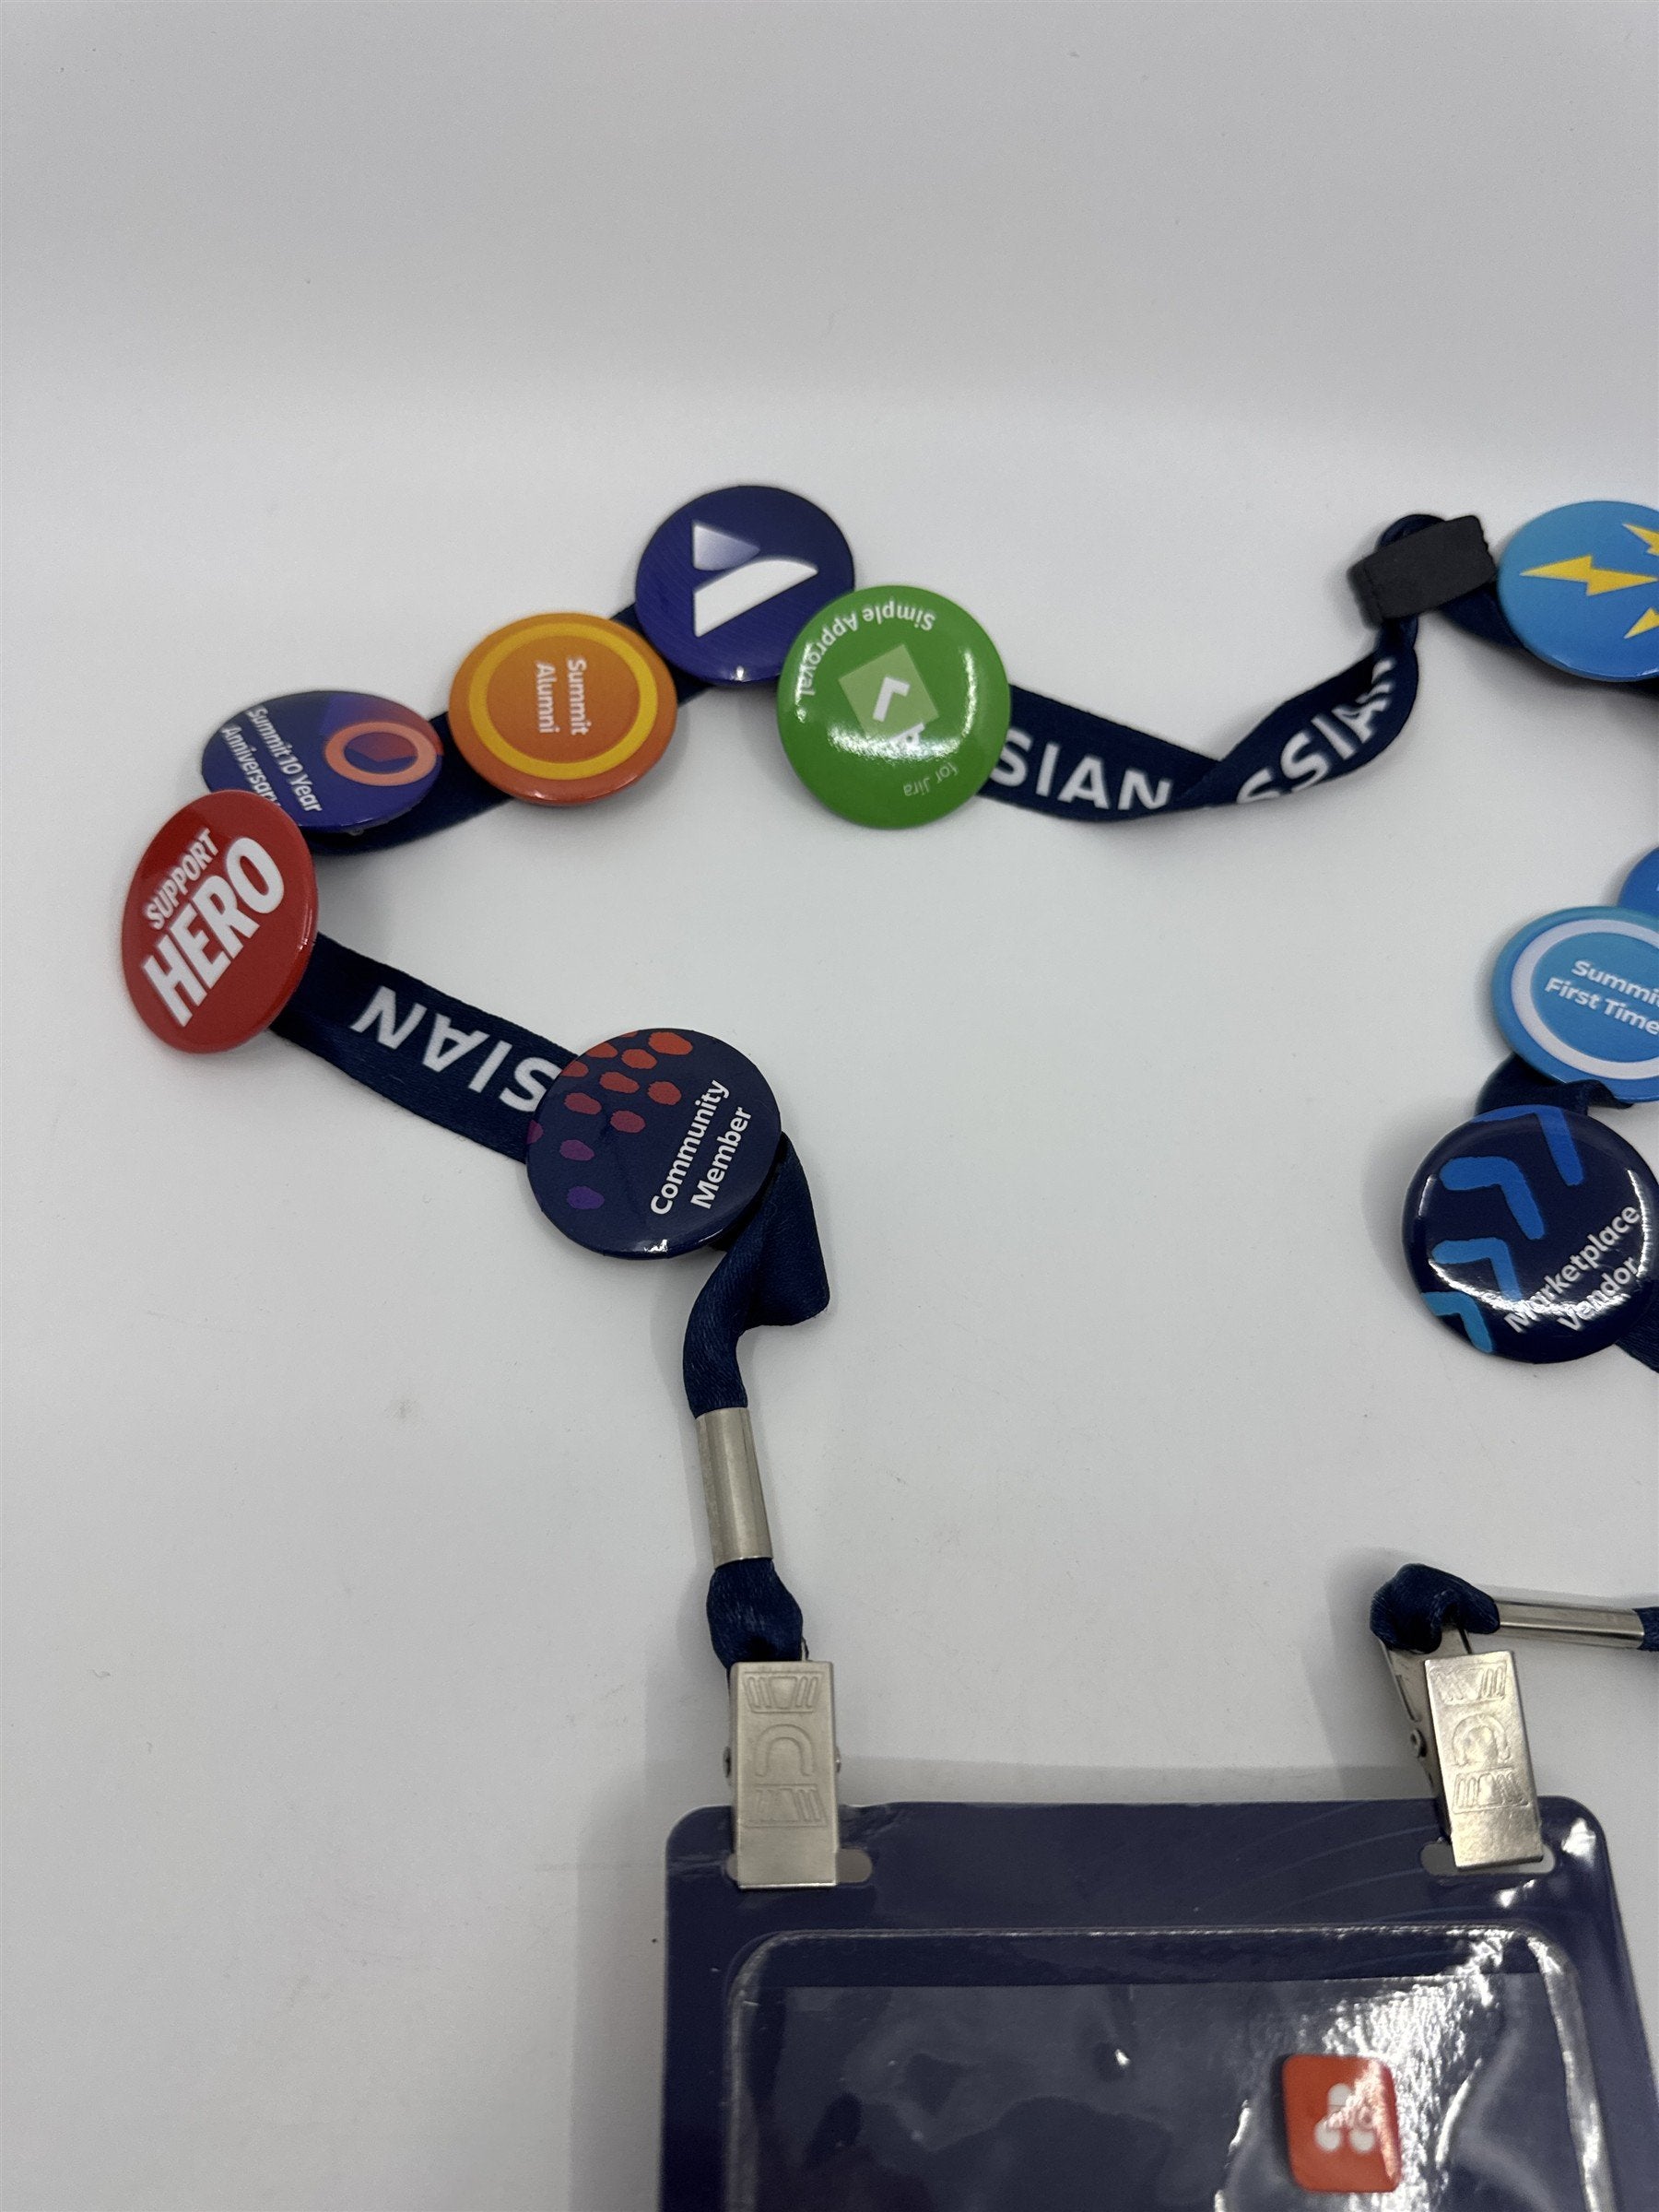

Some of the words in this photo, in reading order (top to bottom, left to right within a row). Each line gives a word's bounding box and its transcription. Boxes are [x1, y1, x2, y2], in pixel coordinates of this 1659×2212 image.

[863, 598, 936, 631] Simple
[798, 613, 858, 696] Approval
[247, 705, 292, 760] Summit
[535, 660, 560, 734] Alumni
[567, 656, 593, 735] Summit
[222, 724, 280, 806] Anniversar
[277, 754, 304, 776] 10
[290, 773, 322, 811] Year
[903, 776, 931, 797] Jira
[935, 760, 959, 783] for
[989, 726, 1174, 811] SIAN
[146, 827, 219, 931] SUPPORT
[142, 835, 285, 1028] HERO
[1544, 975, 1603, 1011] First
[348, 984, 563, 1113] SIAN
[650, 1079, 730, 1216] Community
[689, 1106, 752, 1210] Member
[1503, 1206, 1641, 1335] Marketplace
[1556, 1256, 1640, 1332] Vendor
